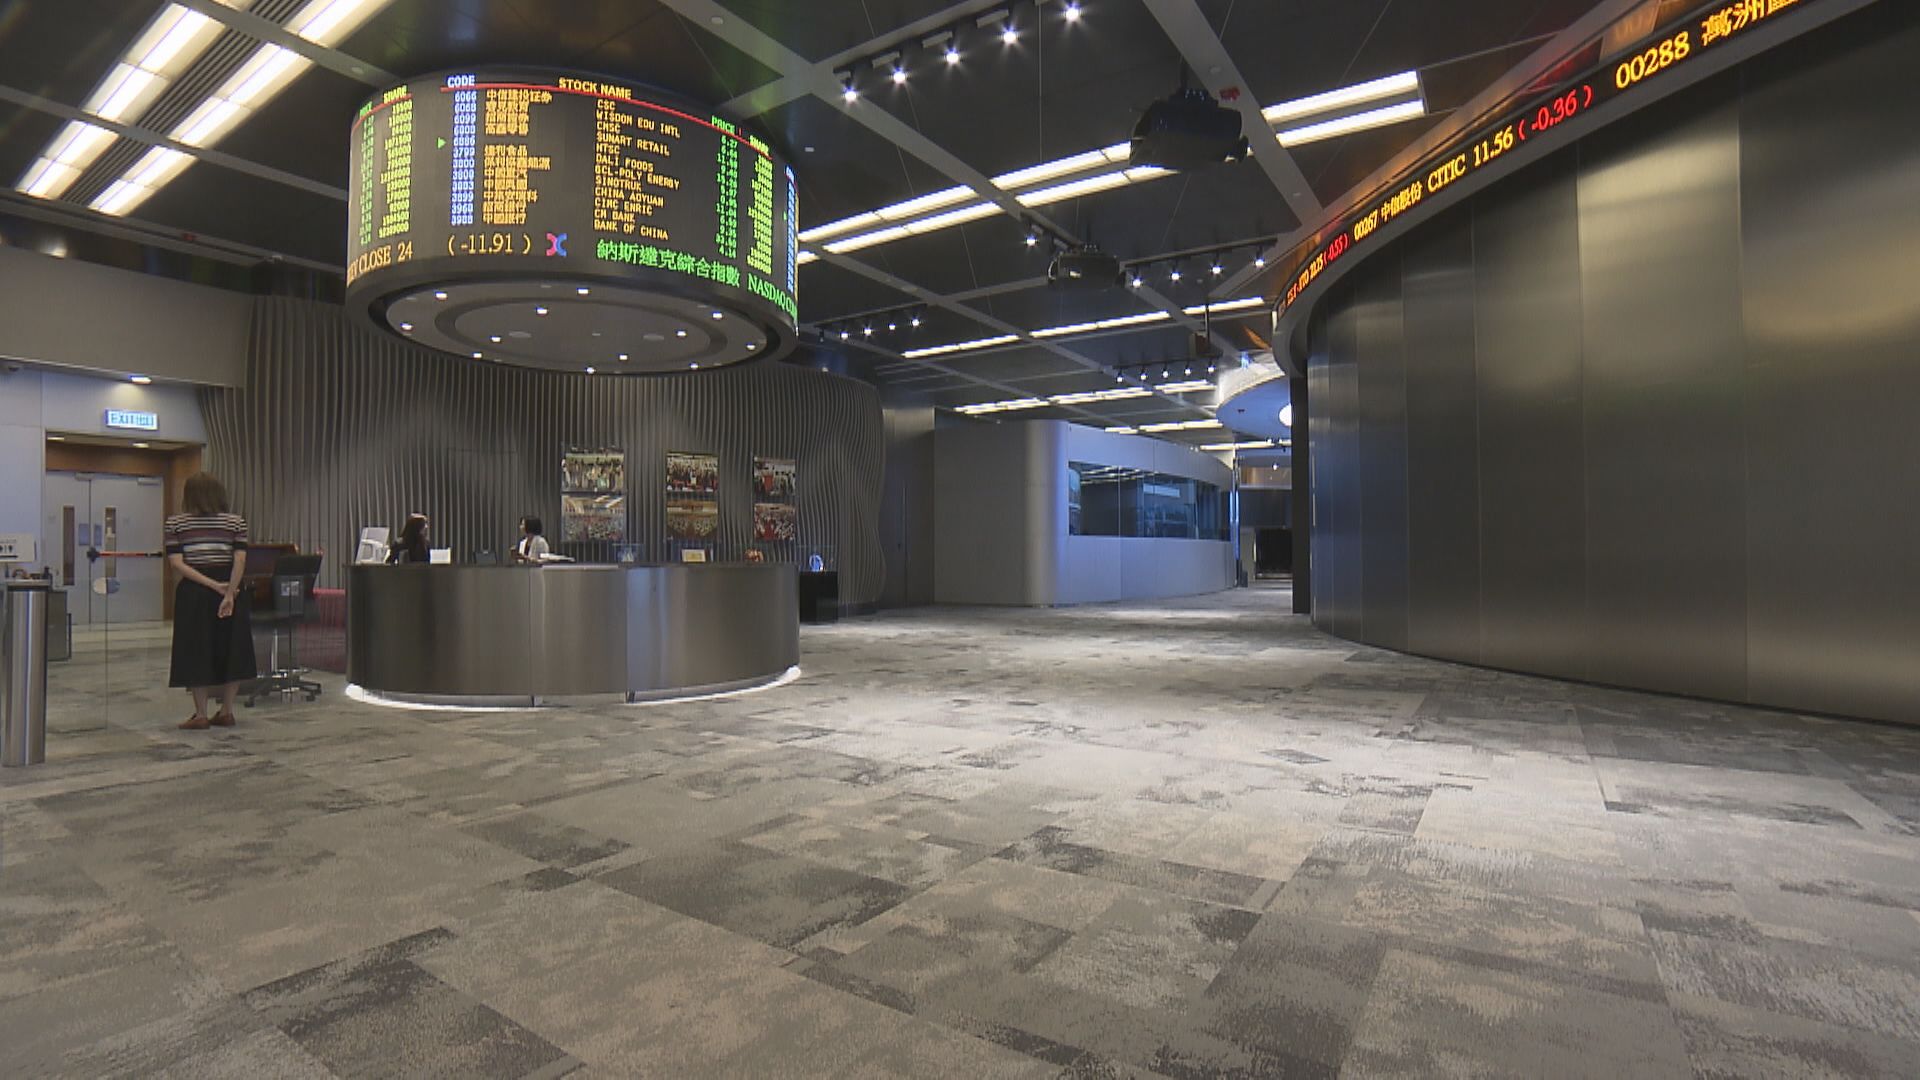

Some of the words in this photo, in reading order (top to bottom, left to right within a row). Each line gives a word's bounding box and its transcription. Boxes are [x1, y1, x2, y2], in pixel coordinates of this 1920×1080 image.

[1616, 31, 1690, 89] 00288
[447, 75, 475, 88] CODE
[559, 77, 597, 93] STOCK
[601, 84, 631, 99] NAME
[712, 115, 735, 135] PRICE
[597, 99, 616, 110] CSC
[454, 113, 476, 124] 6099
[453, 147, 475, 158] 3799
[597, 131, 632, 146] SUNART
[637, 139, 669, 156] RETAIL
[595, 175, 641, 192] SINOTRUK
[647, 173, 679, 190] ENERGY
[1354, 209, 1378, 241] 00267
[1427, 153, 1466, 193] CITIC
[1473, 124, 1514, 167] 11.56
[595, 187, 624, 200] CHINA
[595, 198, 619, 210] CIMC
[624, 202, 653, 216] ENRIC
[594, 219, 617, 232] BANK
[624, 223, 635, 234] OF
[641, 226, 668, 240] CHINA
[359, 245, 391, 274] CLOSE
[398, 241, 413, 262] 24
[748, 273, 785, 310] NASDAQ
[111, 412, 133, 424] EXIT
